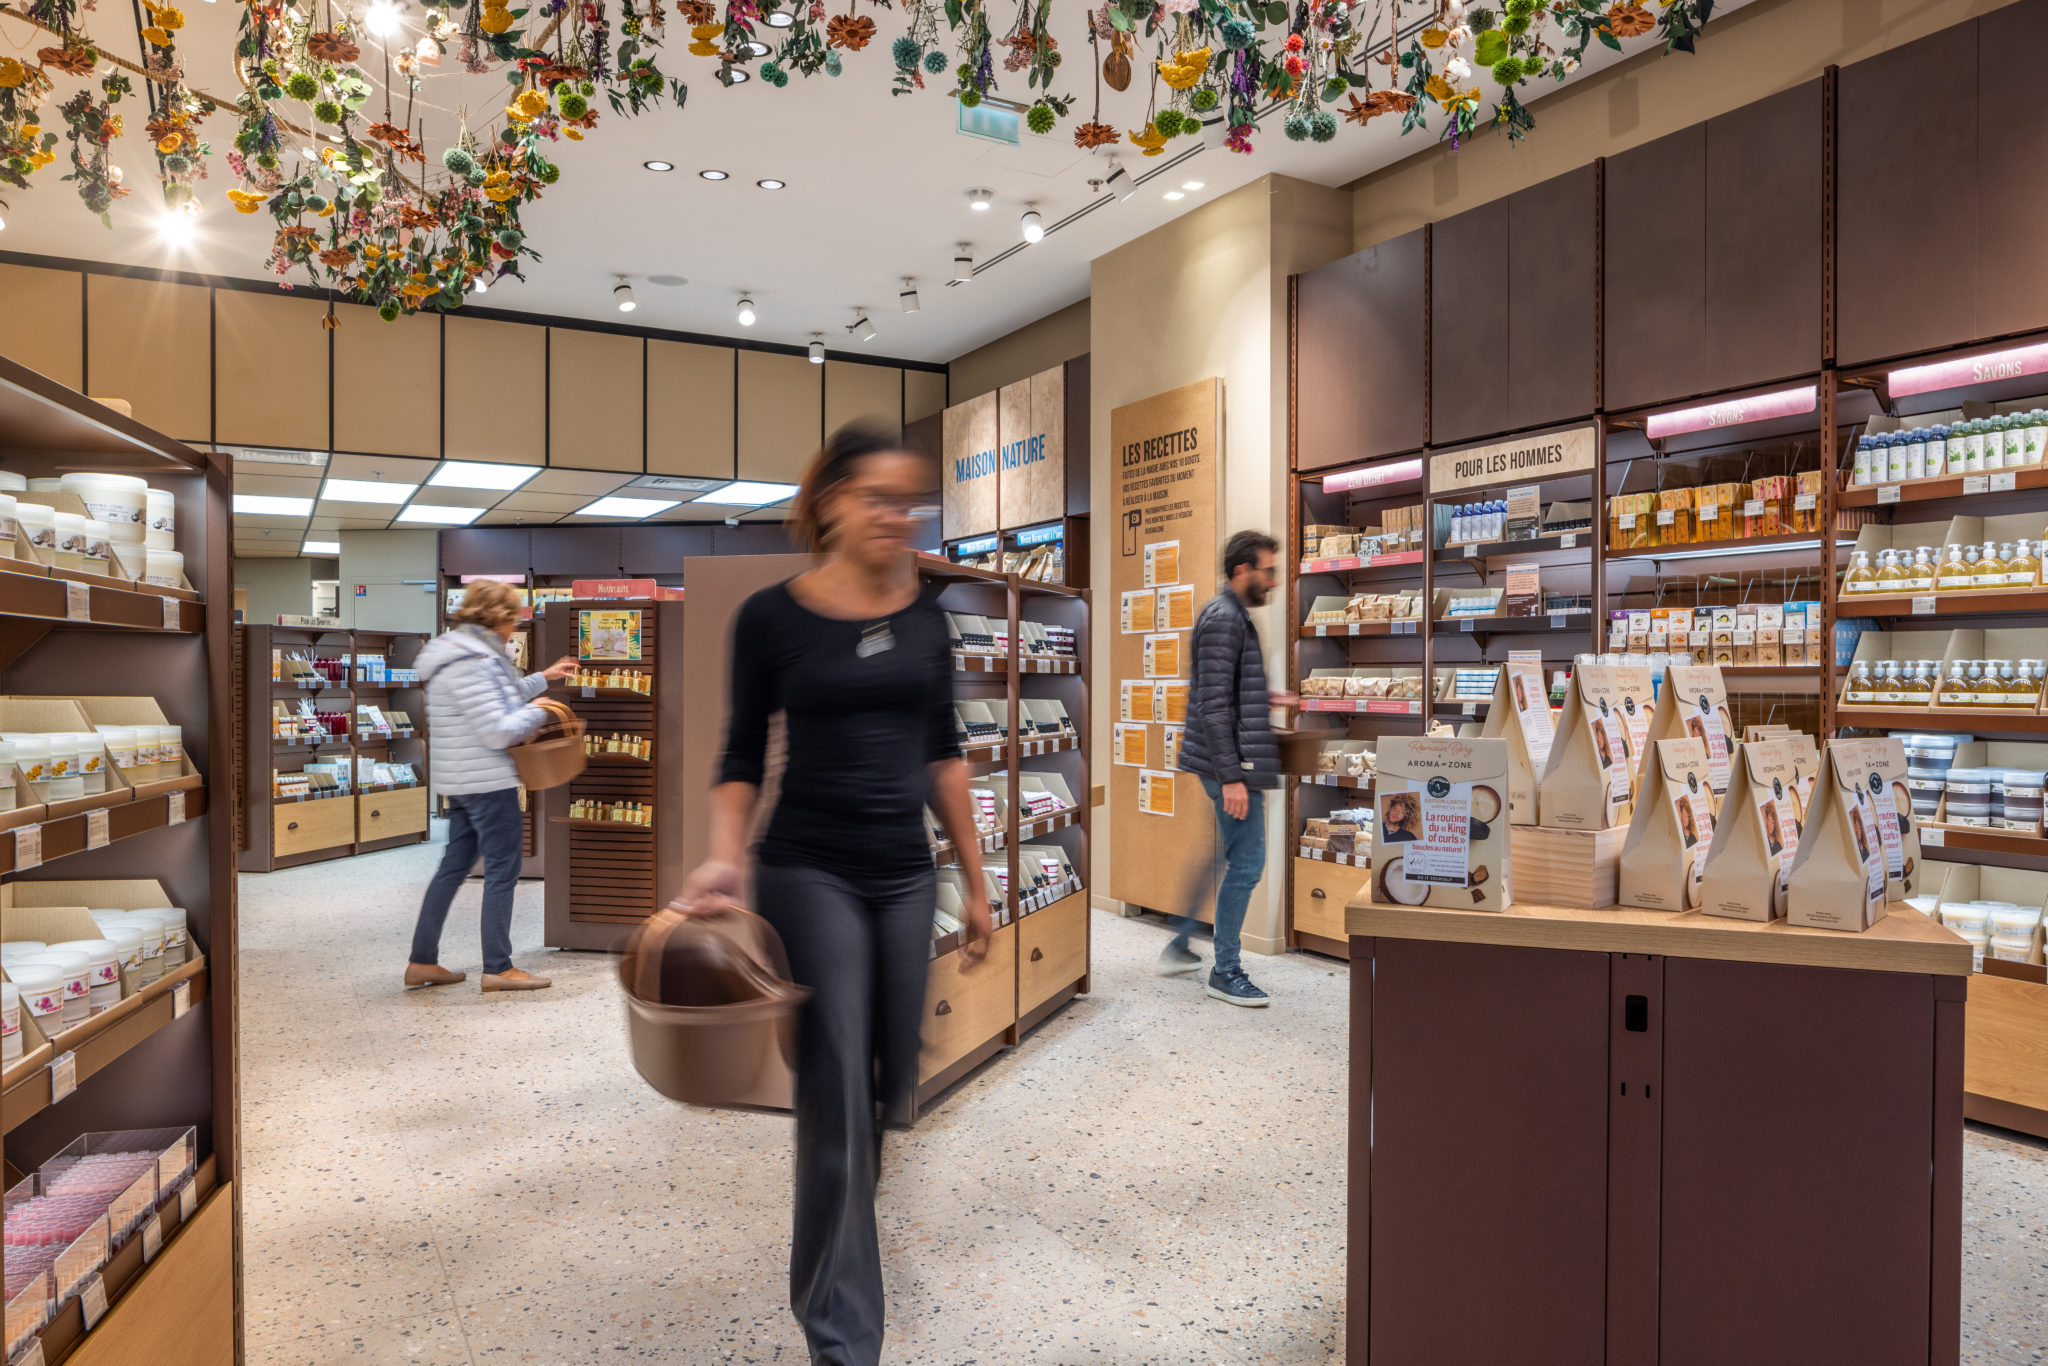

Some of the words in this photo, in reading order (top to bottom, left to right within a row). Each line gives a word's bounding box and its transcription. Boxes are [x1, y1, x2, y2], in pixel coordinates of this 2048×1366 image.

[1122, 442, 1141, 467] LES
[1143, 427, 1198, 462] RECETTES
[956, 449, 996, 483] MAISON
[1002, 433, 1045, 471] NATURE
[1455, 458, 1483, 479] POUR
[1486, 455, 1507, 474] LES
[1510, 444, 1562, 470] HOMMES
[1407, 760, 1440, 768] AROMA
[1426, 812, 1436, 821] La
[1437, 813, 1467, 823] routine
[1429, 823, 1439, 832] du
[1447, 823, 1467, 836] King
[1428, 833, 1437, 843] of
[1438, 834, 1459, 844] curls
